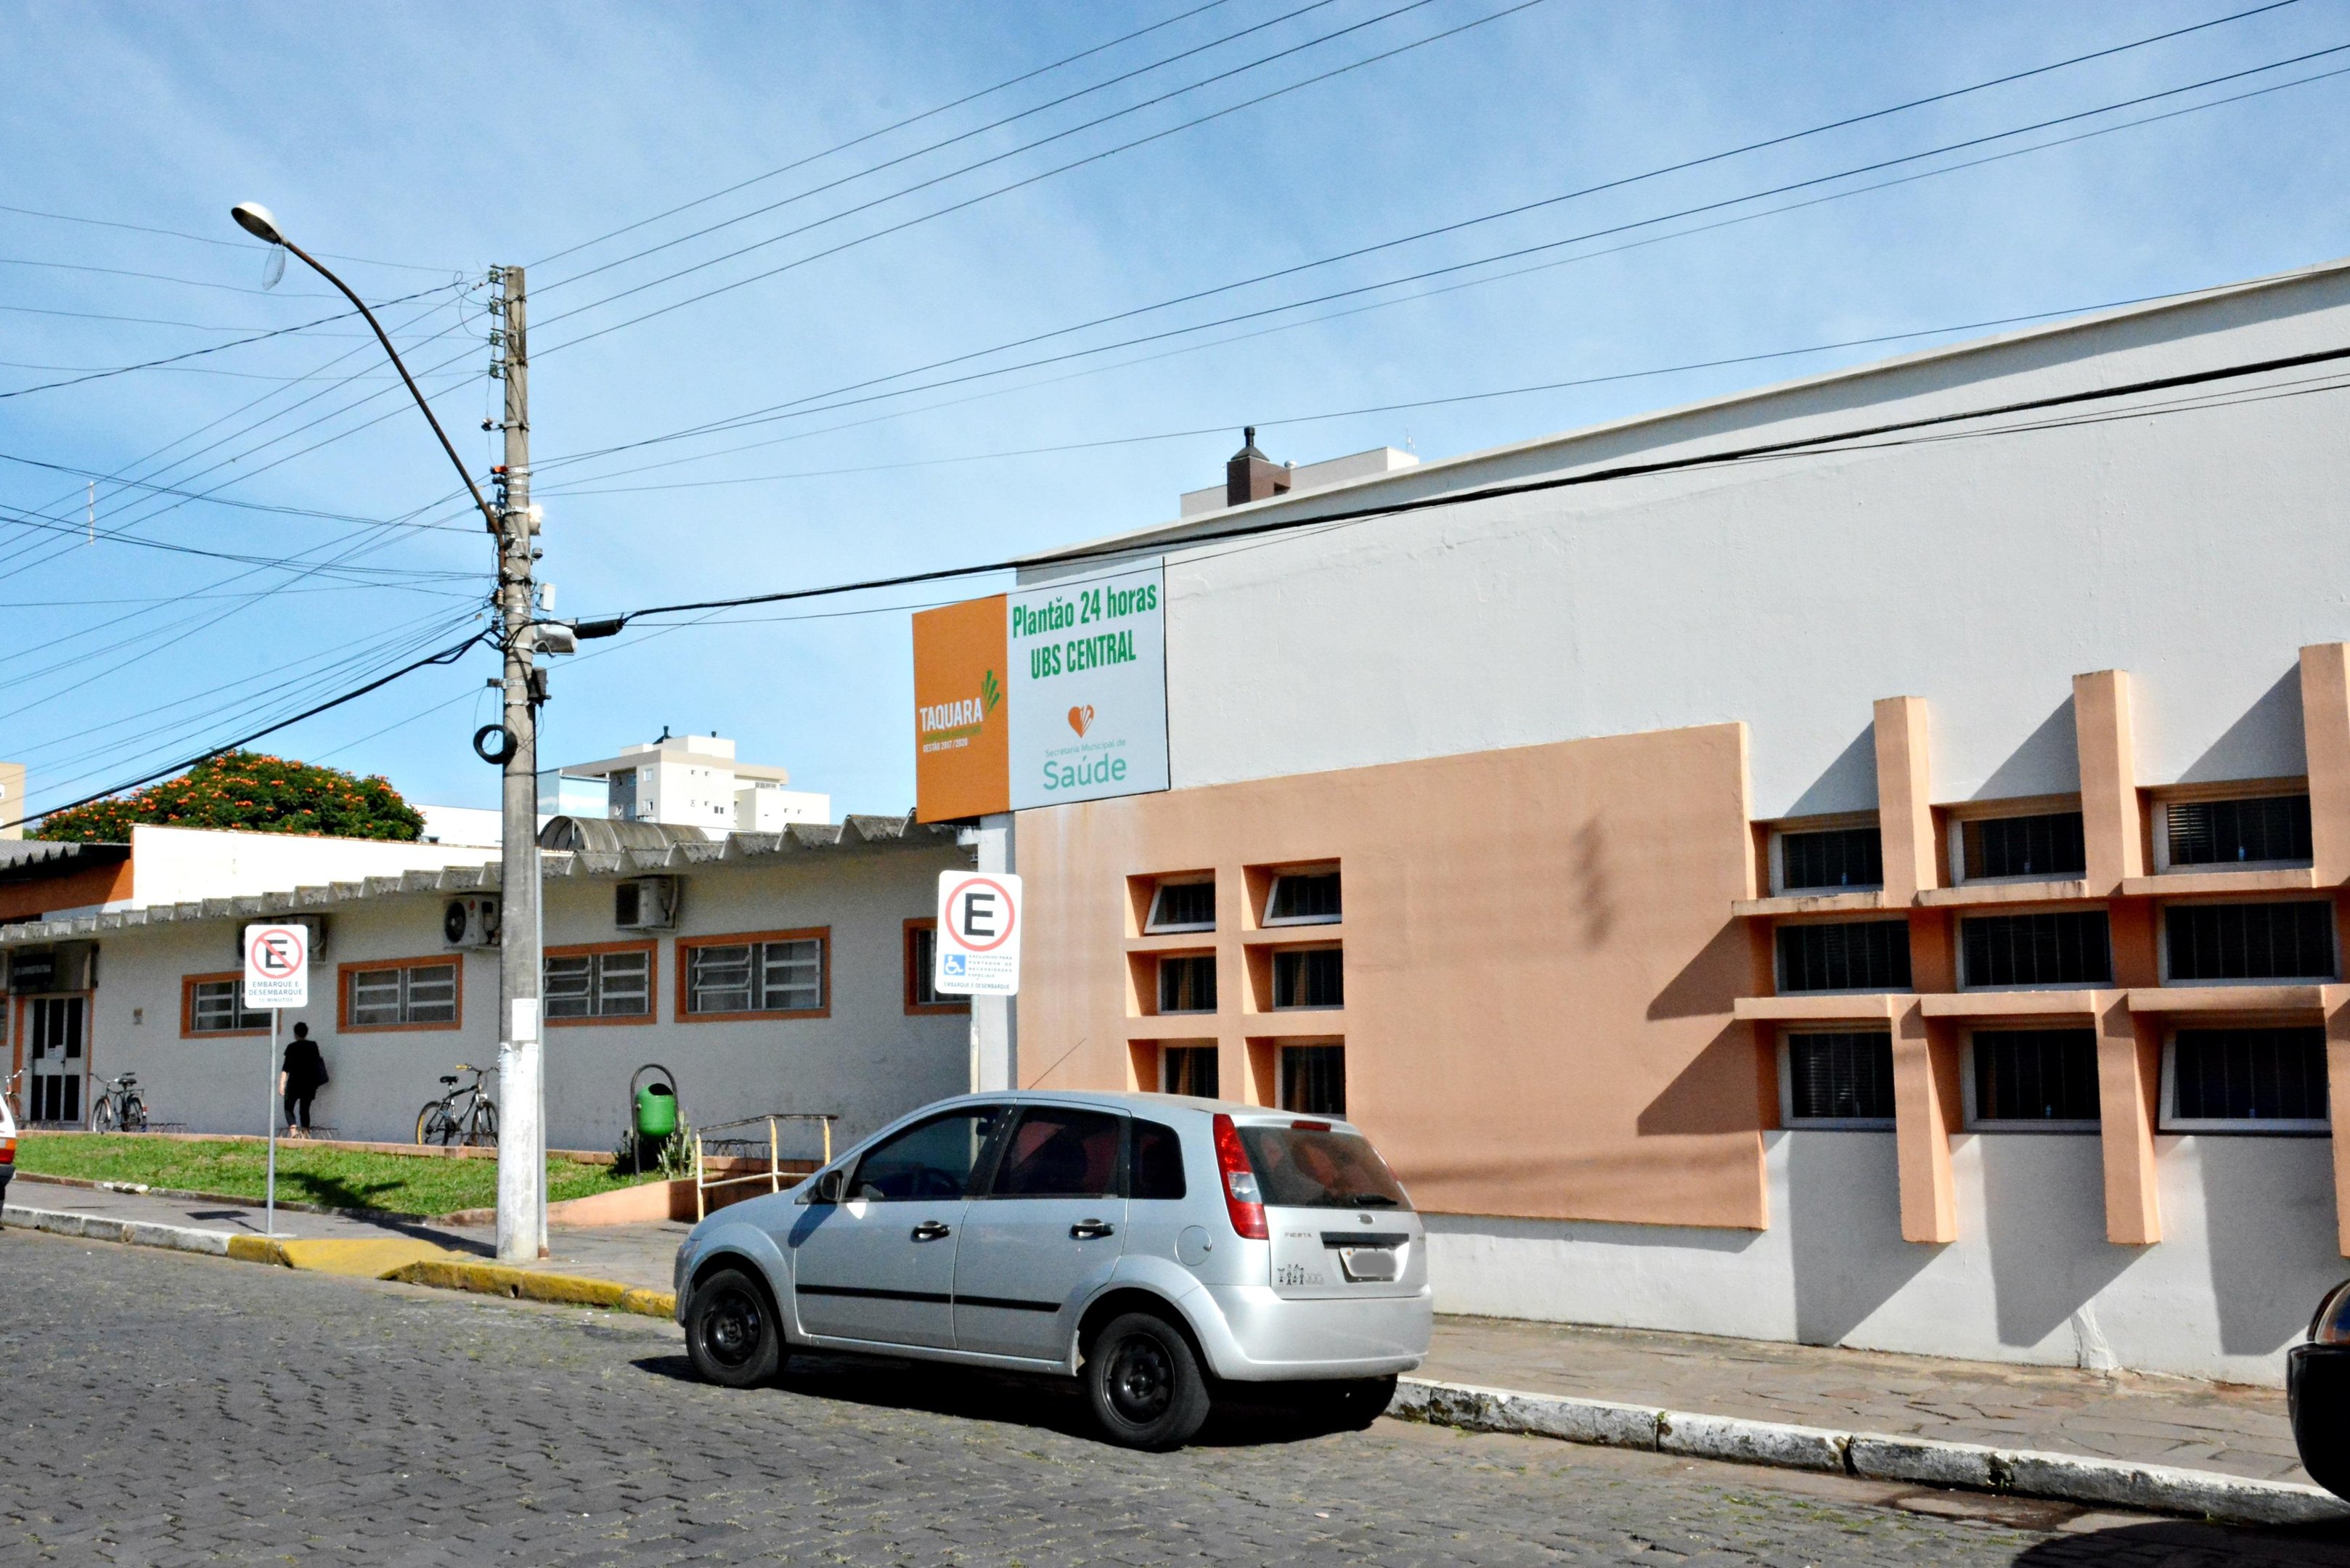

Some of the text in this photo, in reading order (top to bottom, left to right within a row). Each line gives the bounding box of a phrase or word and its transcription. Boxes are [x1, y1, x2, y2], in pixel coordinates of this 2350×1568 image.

[1013, 584, 1157, 638] Plantão 24 horas
[1031, 629, 1137, 679] UBS CENTRAL
[919, 697, 984, 732] TAQUARA
[1045, 746, 1080, 757] Secretaria
[1081, 739, 1115, 752] Municipal
[1043, 753, 1127, 791] Saúde
[964, 893, 995, 936] E
[265, 939, 288, 968] E
